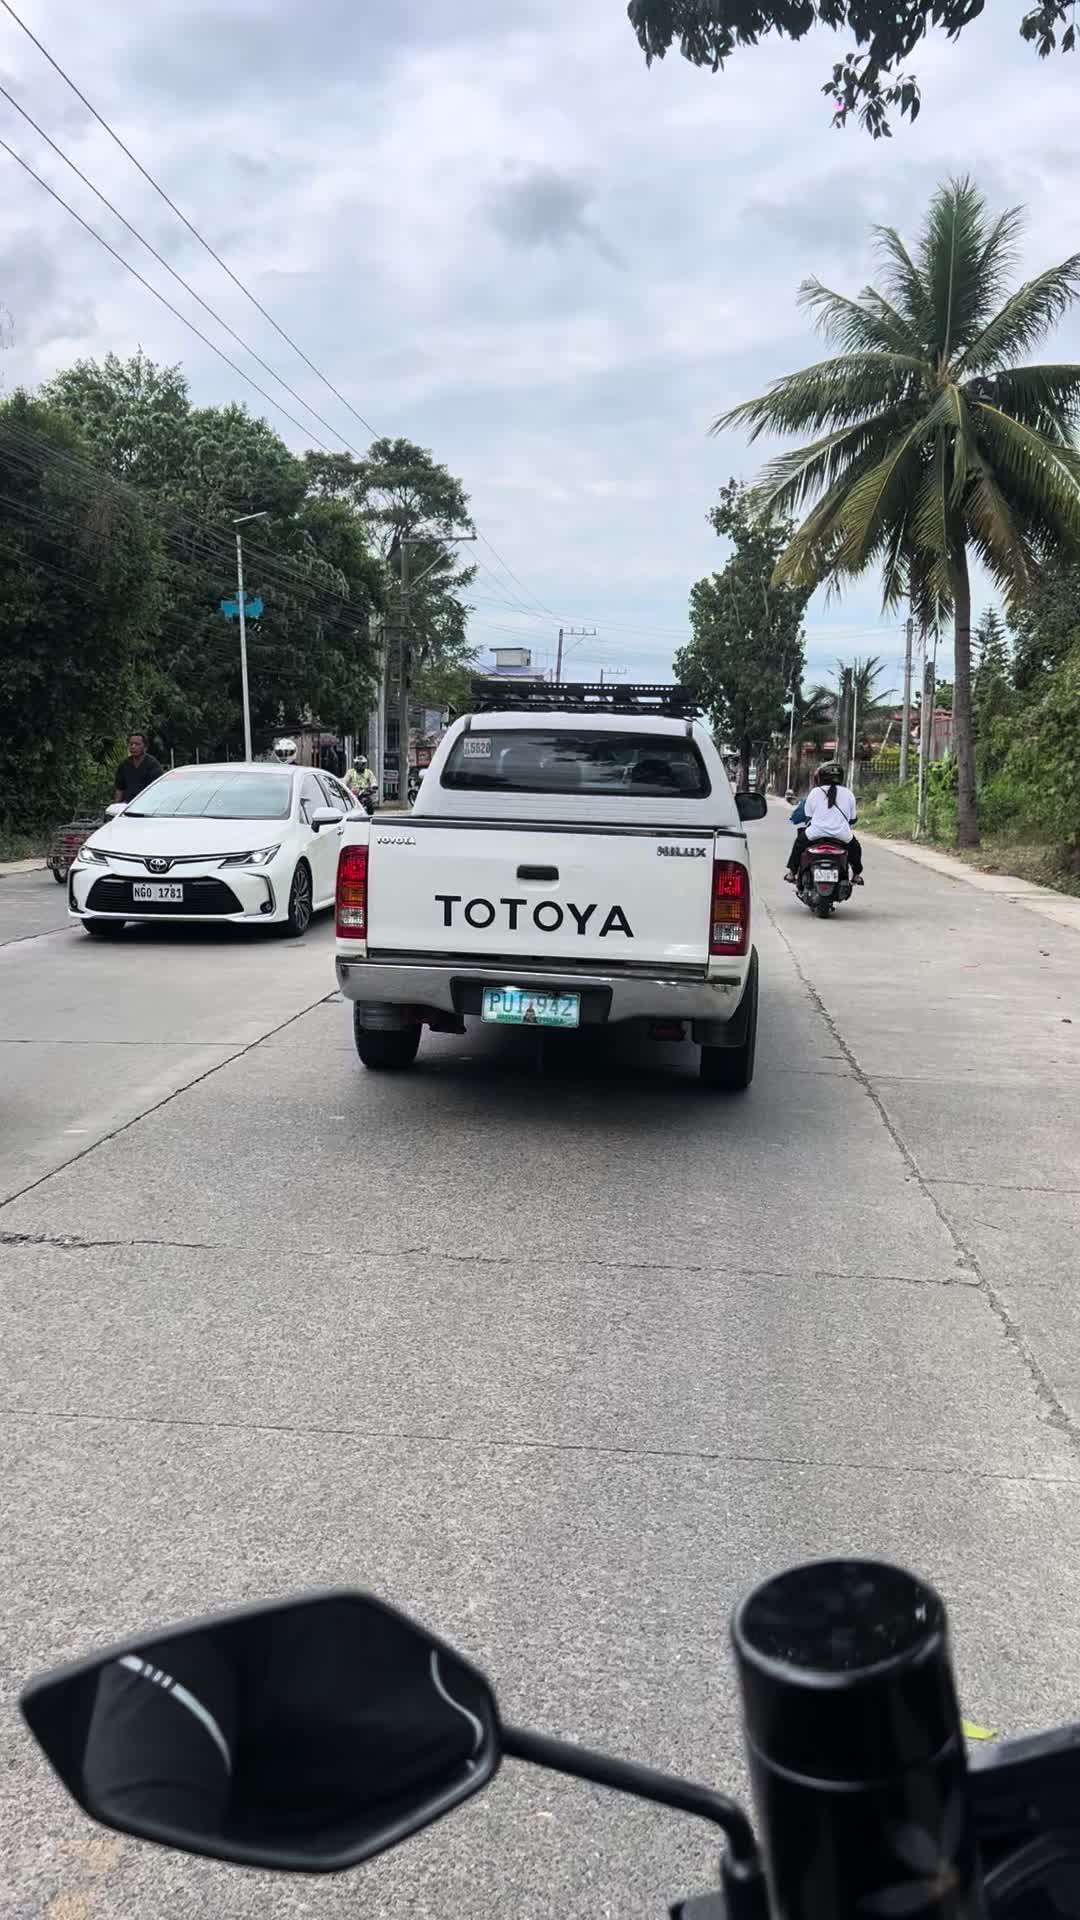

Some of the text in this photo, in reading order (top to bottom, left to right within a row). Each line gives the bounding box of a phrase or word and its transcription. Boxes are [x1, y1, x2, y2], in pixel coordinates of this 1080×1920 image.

[158, 887, 182, 899] 1781
[434, 894, 635, 938] TOTOYA
[536, 995, 573, 1017] 942
